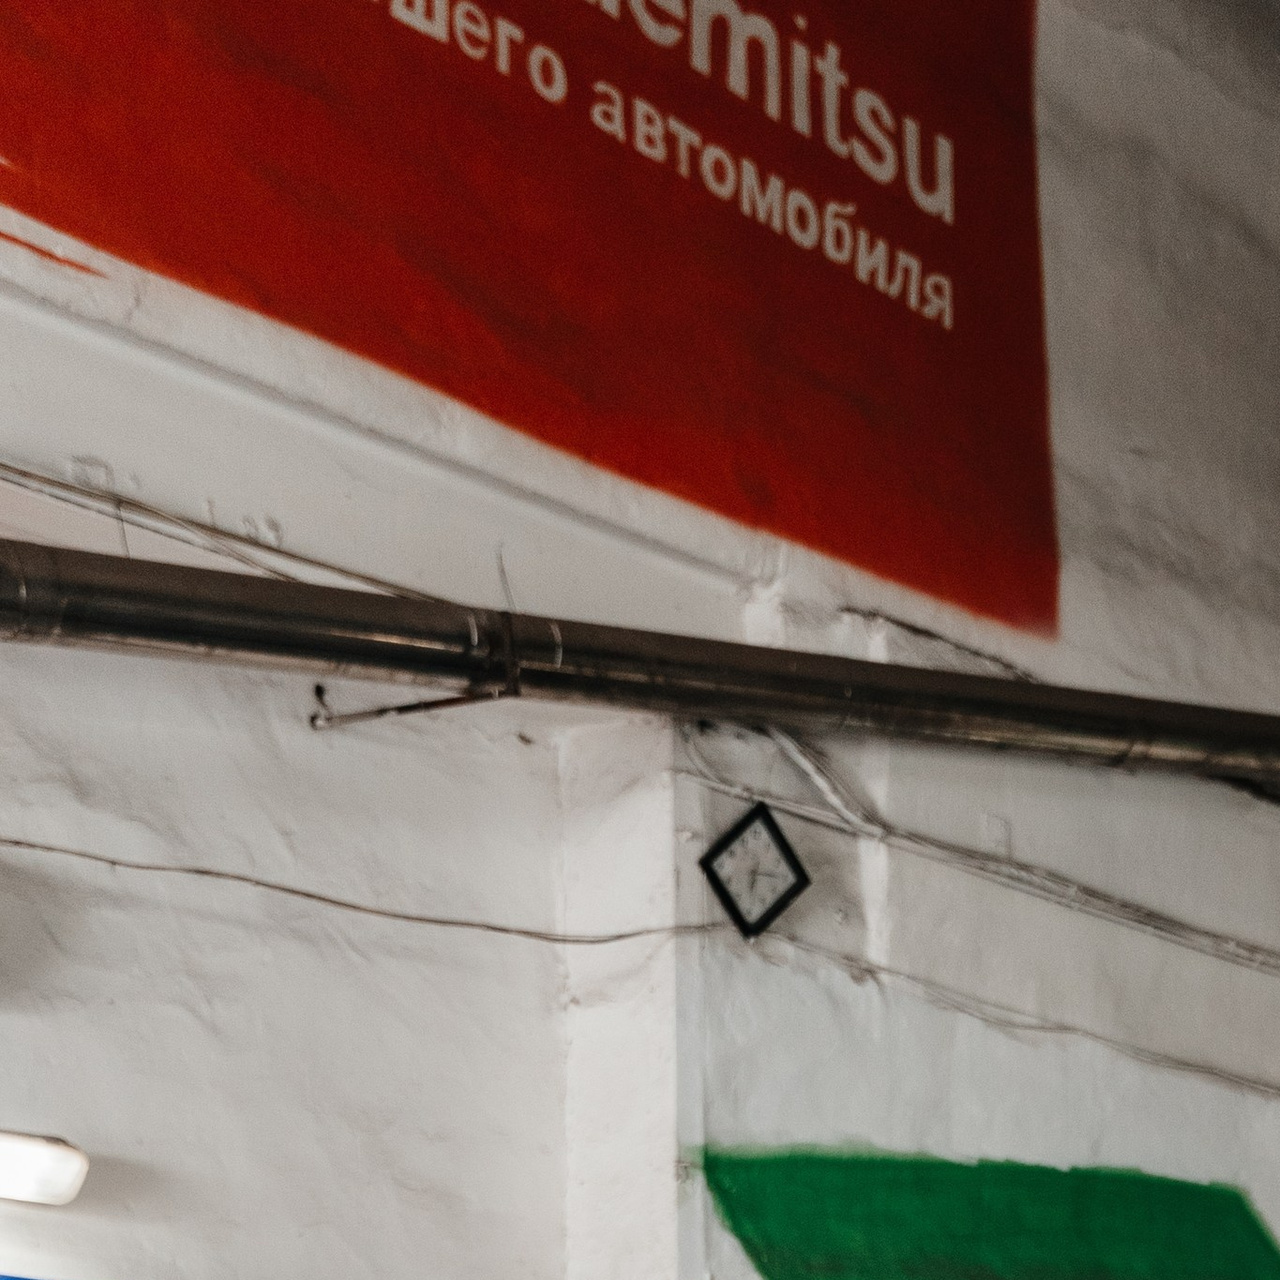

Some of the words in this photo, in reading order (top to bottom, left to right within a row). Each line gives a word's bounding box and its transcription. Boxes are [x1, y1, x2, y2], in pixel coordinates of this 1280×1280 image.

[366, 0, 568, 104] шего
[590, 80, 954, 330] автомобиля
[592, 0, 954, 224] emitsu
